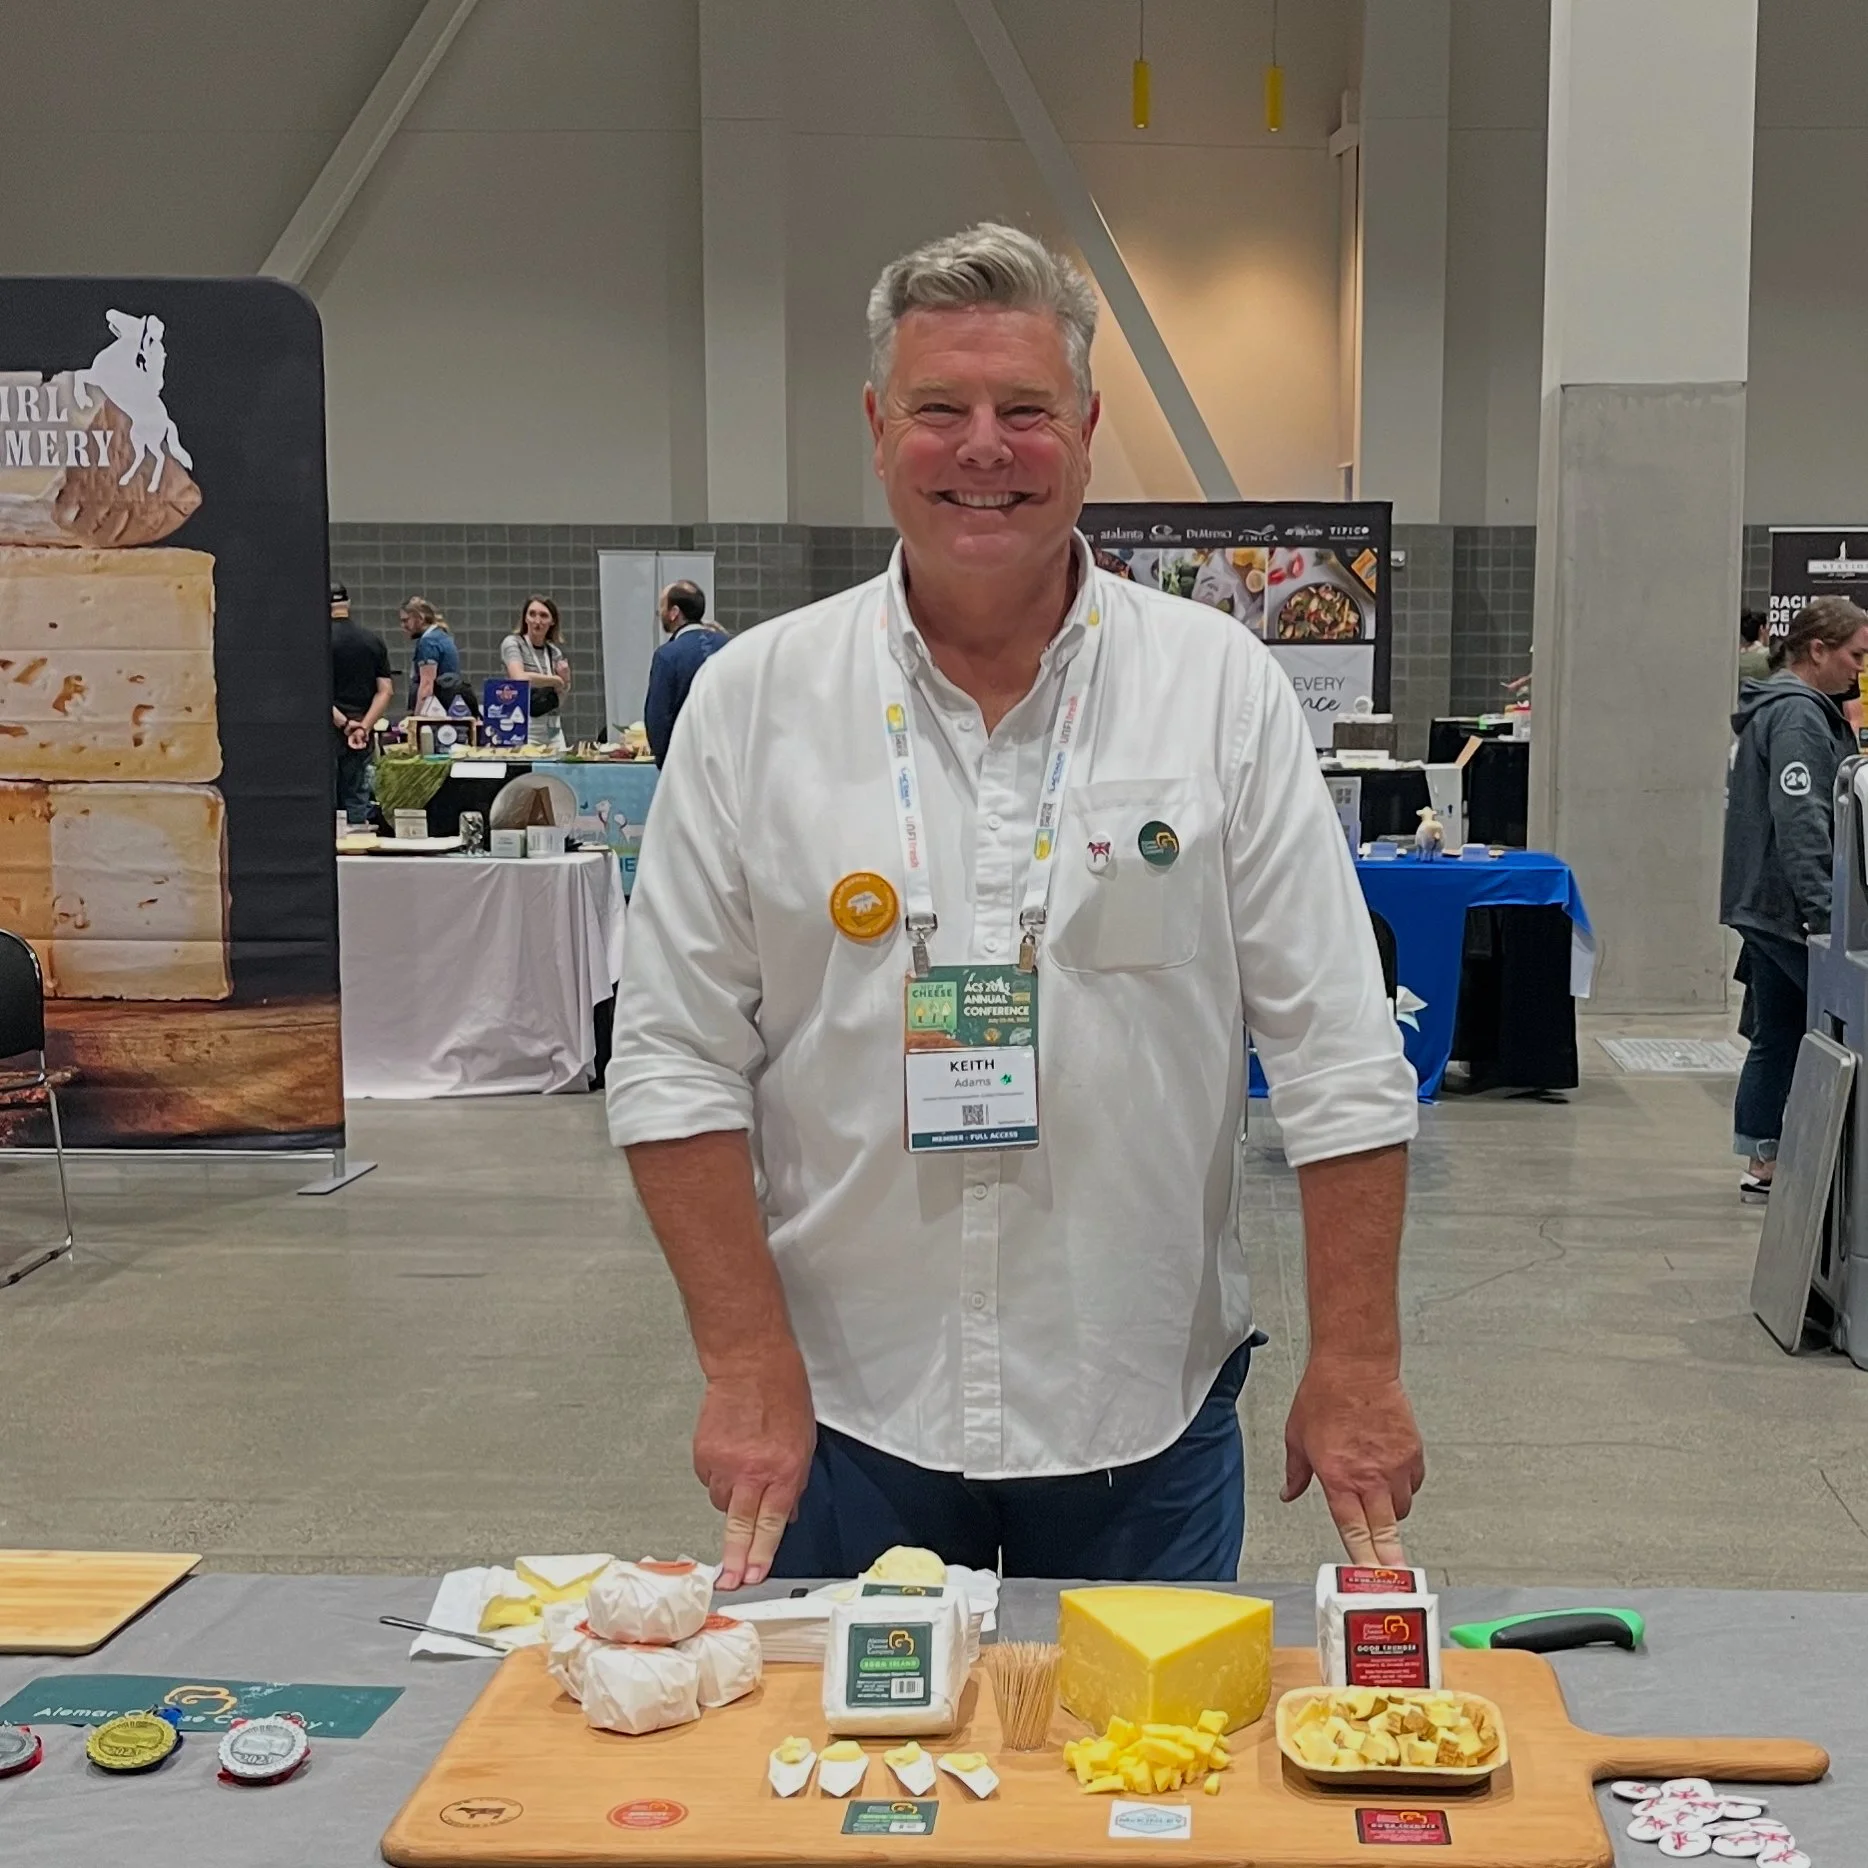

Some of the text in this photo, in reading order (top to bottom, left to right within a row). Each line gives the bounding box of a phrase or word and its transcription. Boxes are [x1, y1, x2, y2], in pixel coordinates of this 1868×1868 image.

[1769, 623, 1790, 636] AU
[1293, 676, 1346, 691] EVERY
[912, 988, 952, 998] CHEESE
[964, 994, 1008, 1004] ANNUAL
[963, 1006, 1030, 1017] CONFERENCE
[950, 1058, 995, 1072] KEITH
[954, 1078, 992, 1088] Adams
[970, 1132, 989, 1141] FULL
[989, 1131, 1018, 1140] ACCESS
